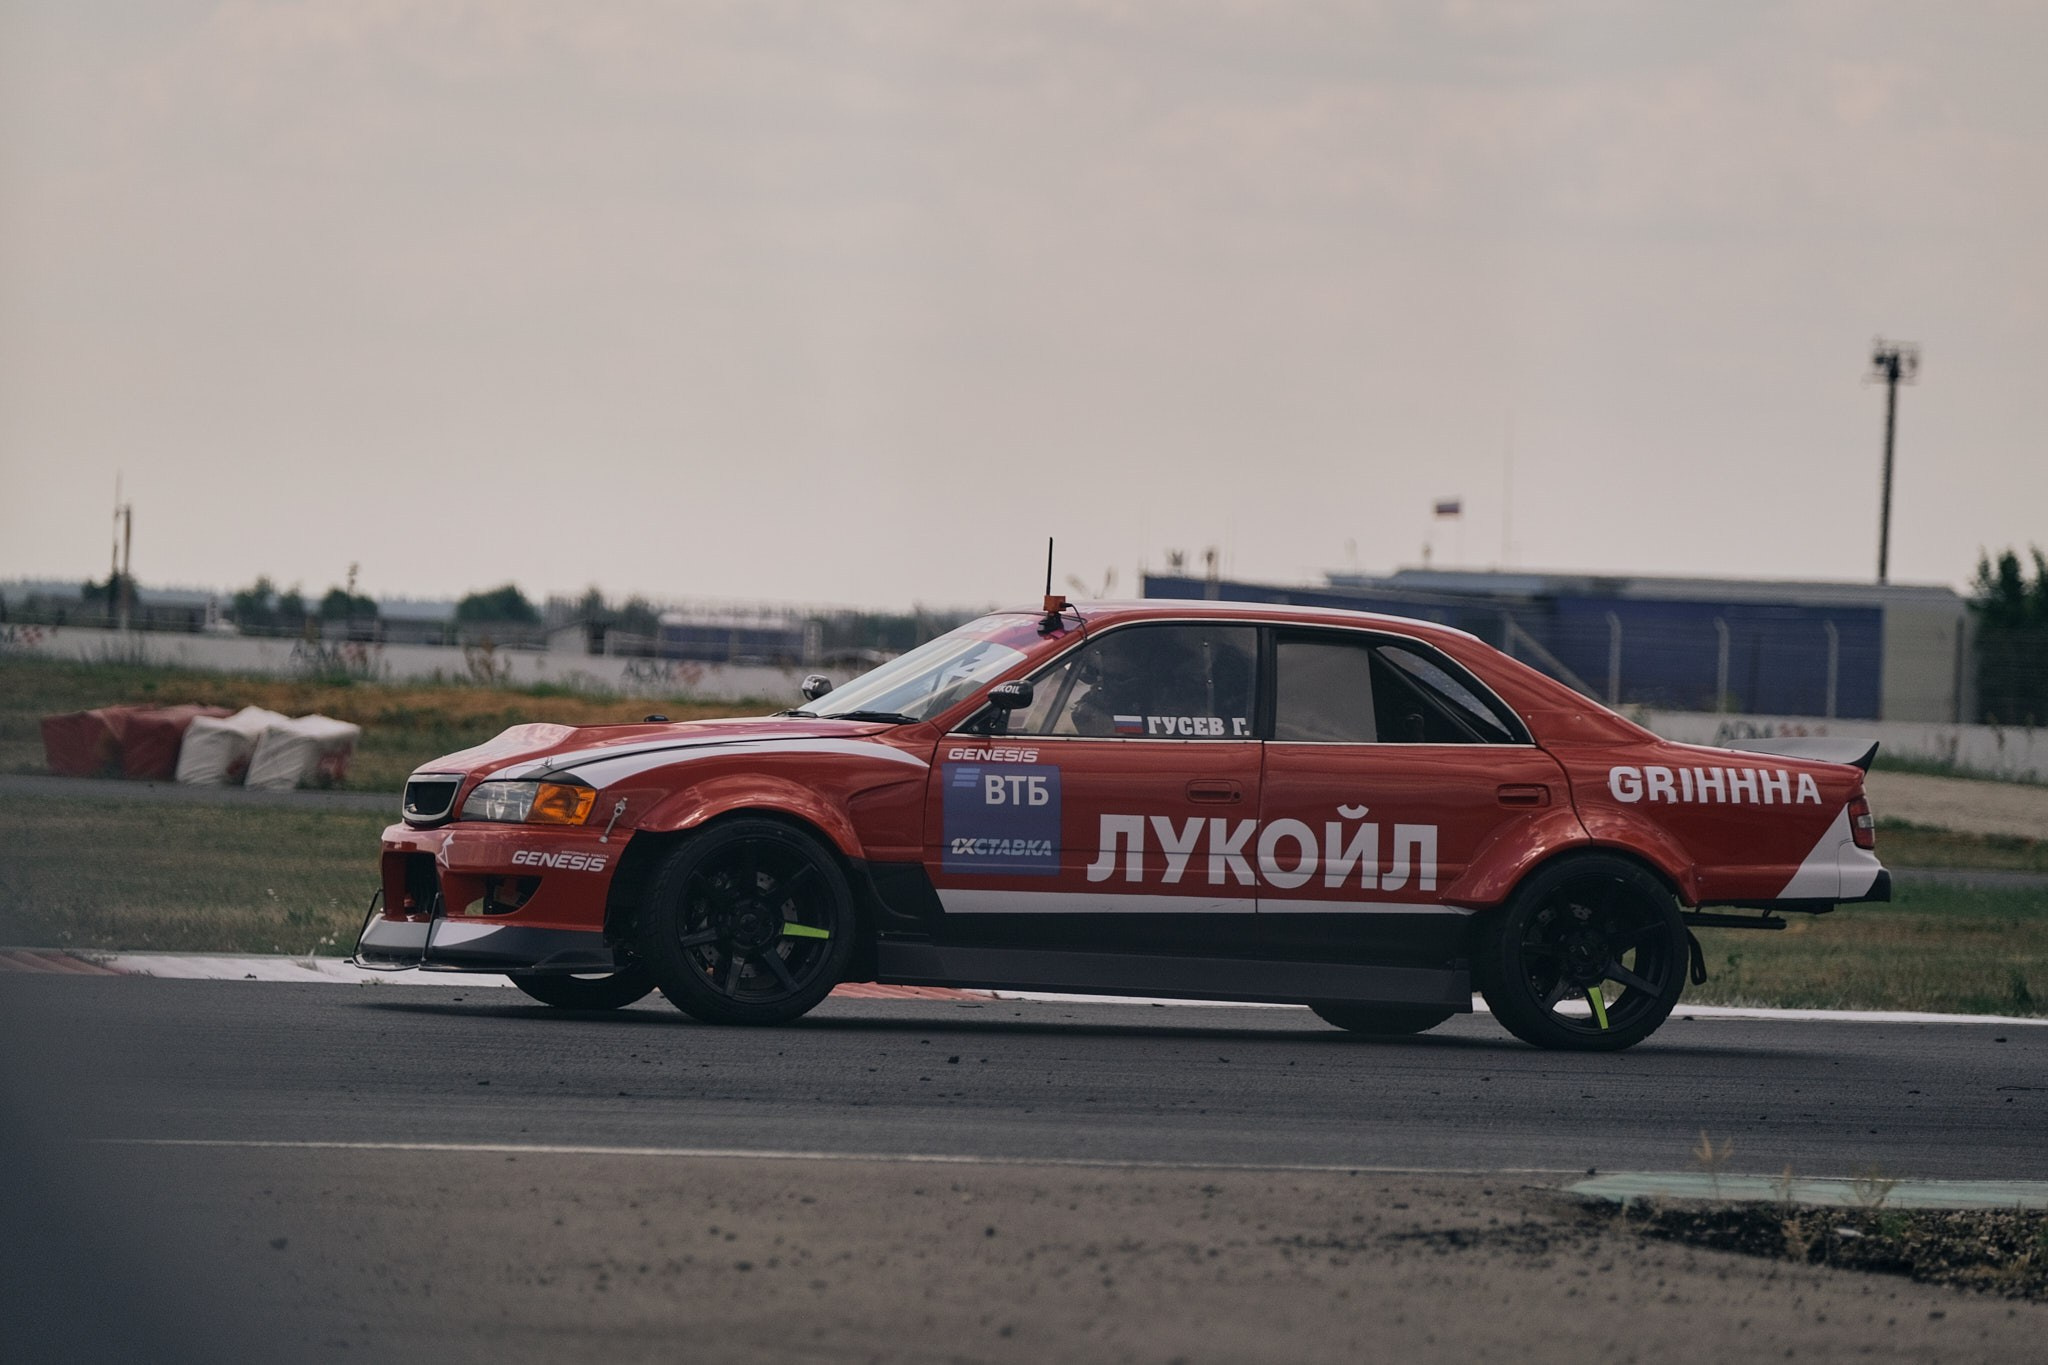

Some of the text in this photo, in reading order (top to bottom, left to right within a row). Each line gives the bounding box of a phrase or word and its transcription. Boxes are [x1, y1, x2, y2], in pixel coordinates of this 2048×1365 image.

[1147, 716, 1250, 736] ГУСЕВ Г.
[948, 748, 1038, 763] GENESIS
[985, 774, 1049, 806] ВТБ
[1087, 804, 1438, 892] ЛУКОЙЛ
[512, 850, 607, 872] GENESIS
